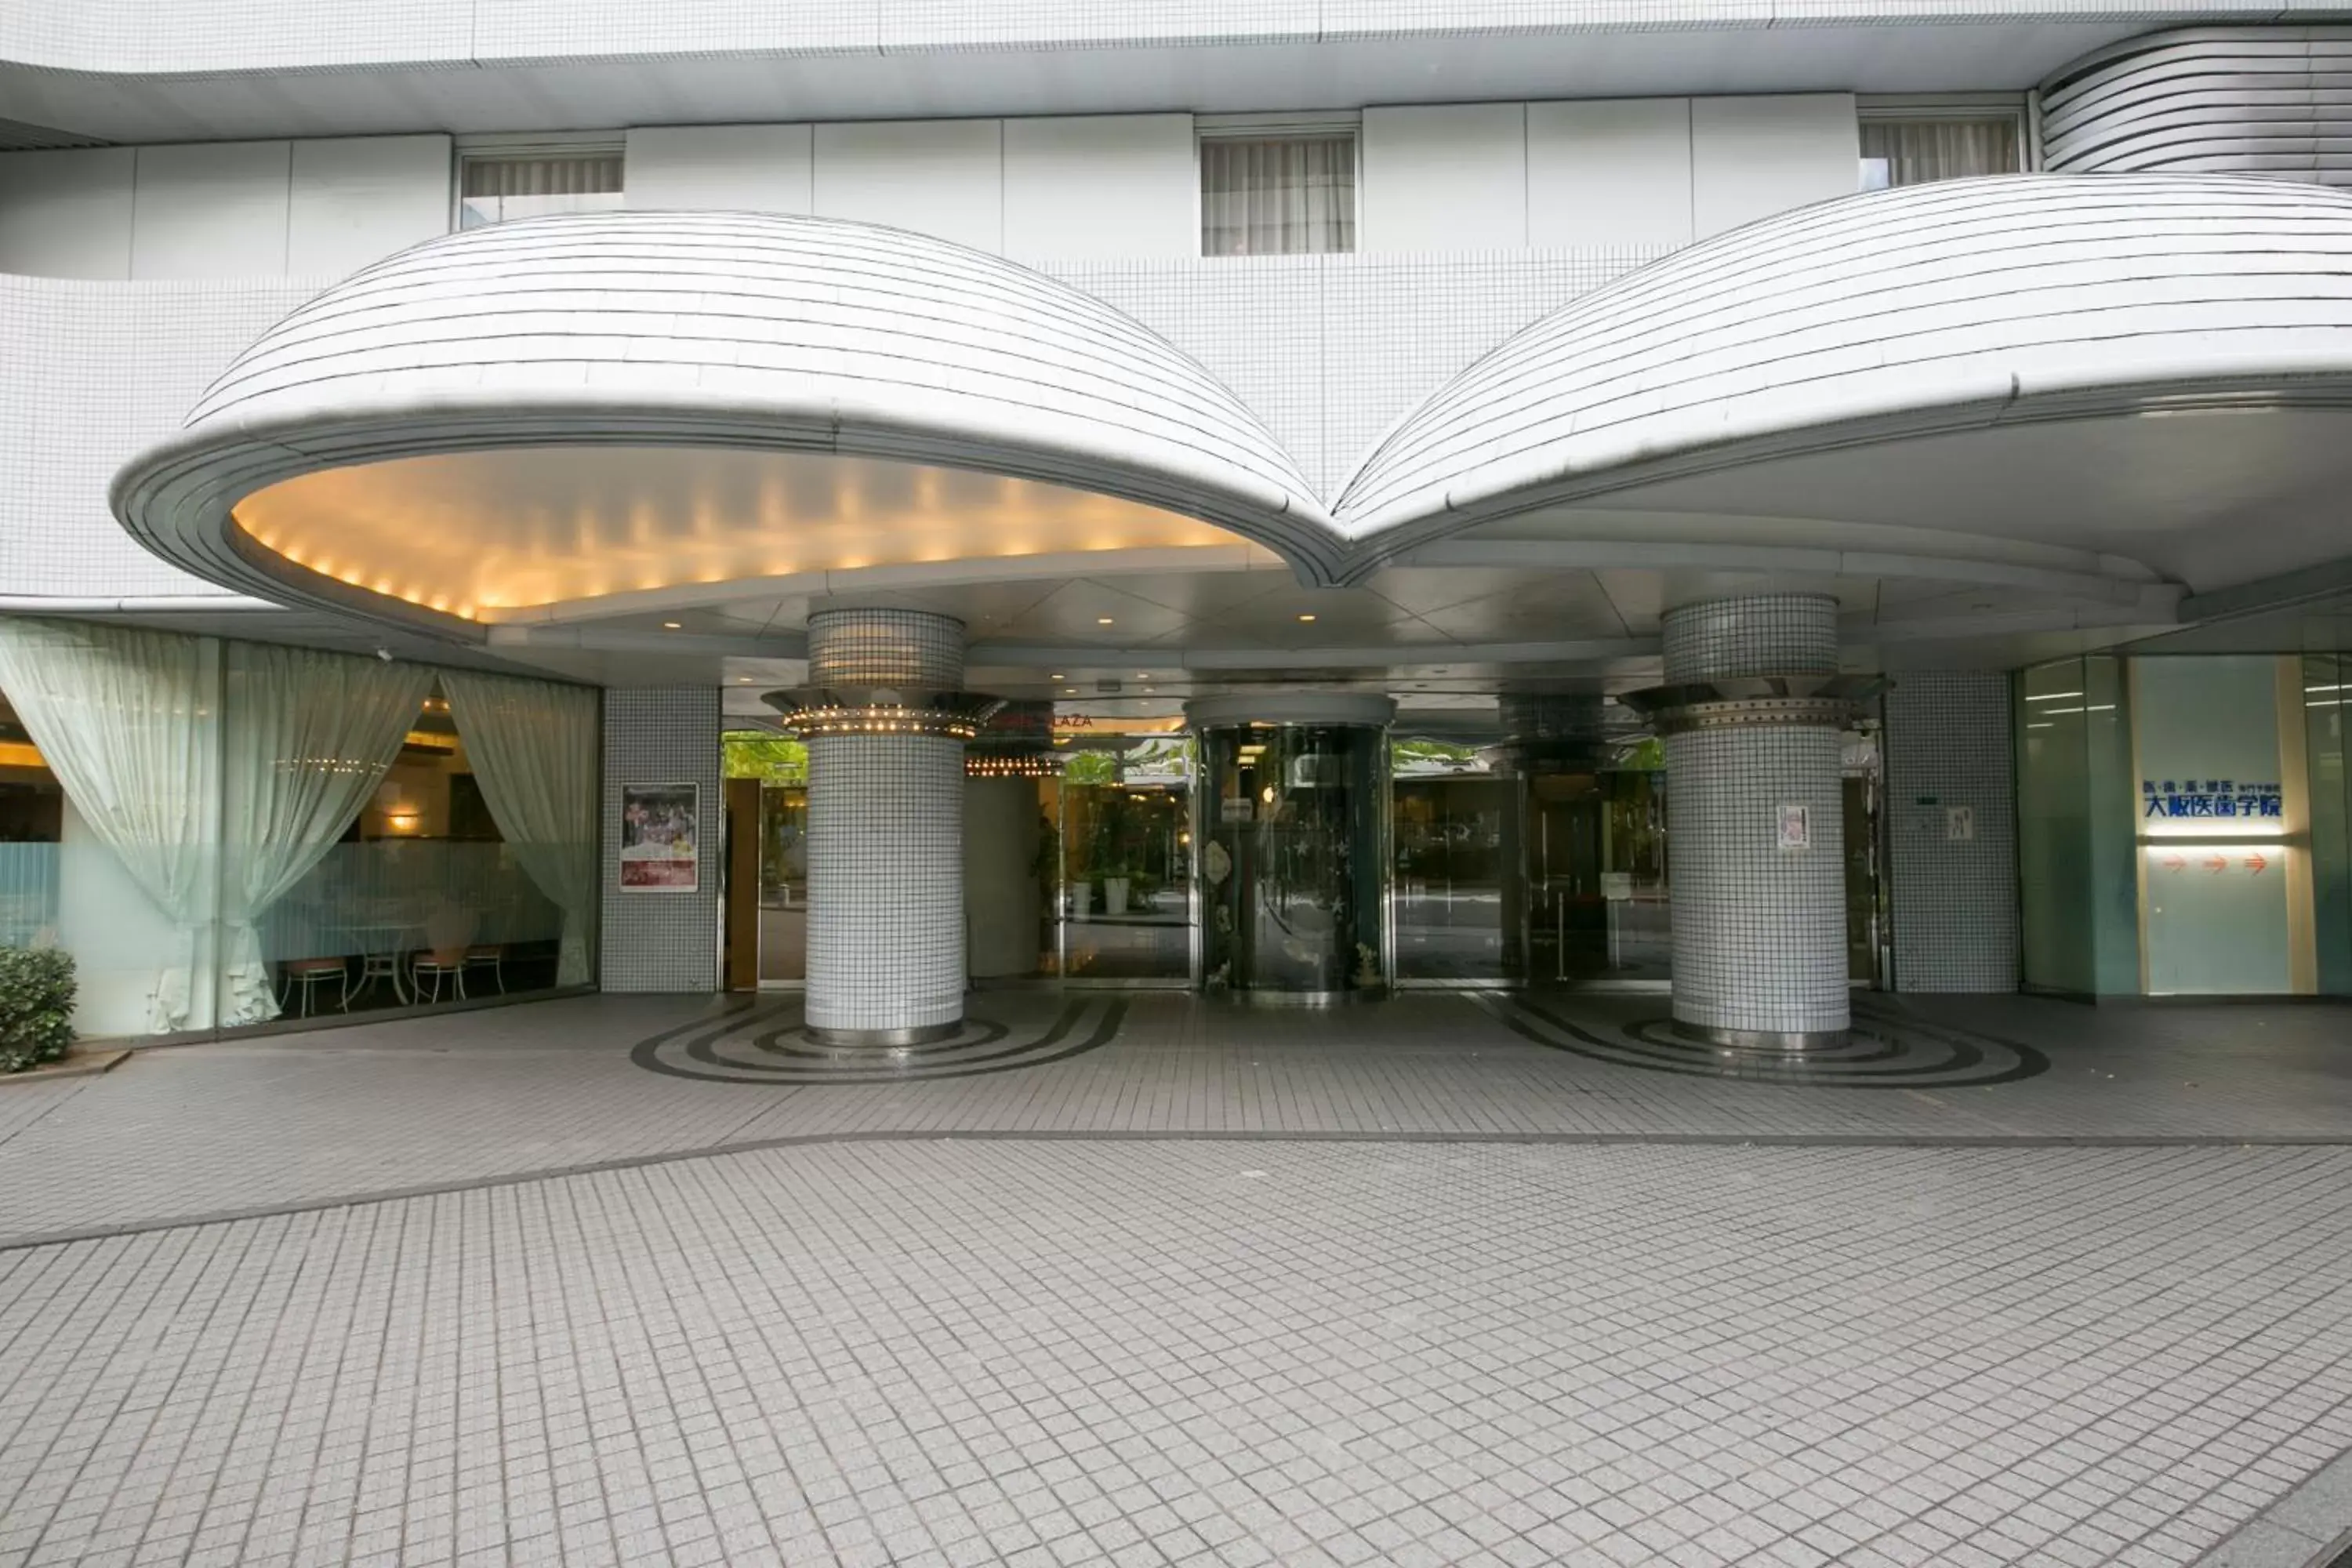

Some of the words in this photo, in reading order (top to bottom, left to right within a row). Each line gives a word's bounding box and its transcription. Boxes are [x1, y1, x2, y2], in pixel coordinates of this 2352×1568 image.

[2144, 795, 2282, 817] 大阪医歯学院
